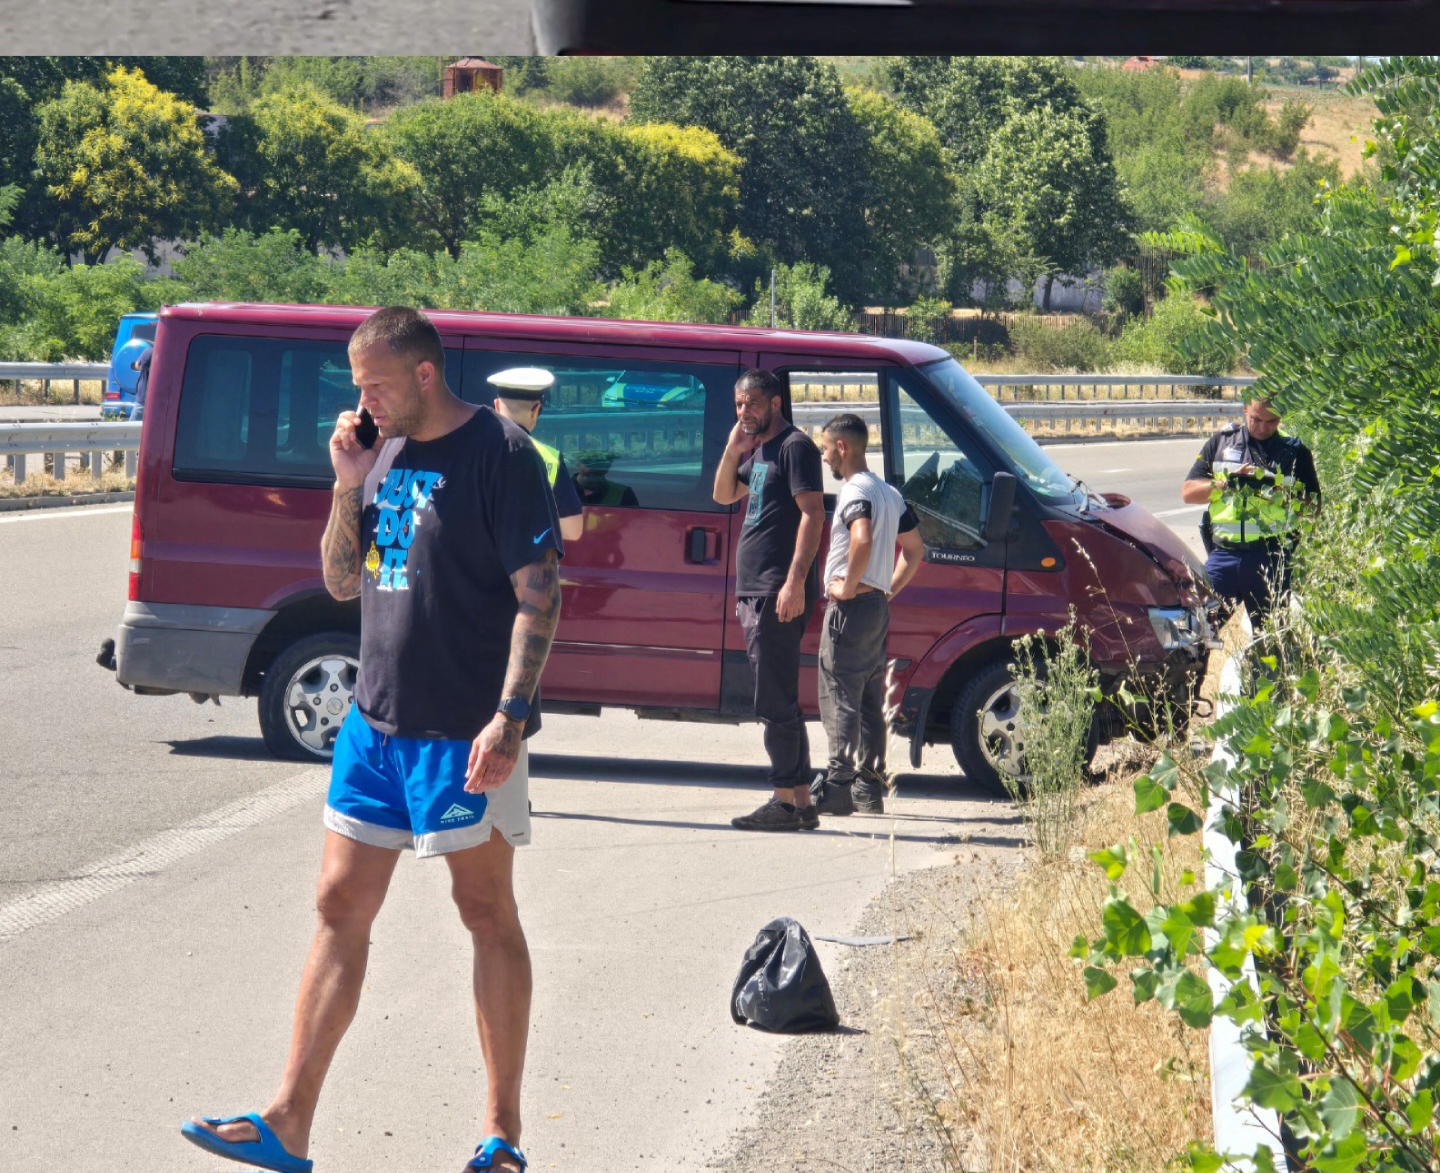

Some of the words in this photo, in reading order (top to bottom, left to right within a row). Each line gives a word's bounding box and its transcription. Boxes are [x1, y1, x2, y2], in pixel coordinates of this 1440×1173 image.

[373, 468, 443, 509] JUST
[376, 506, 416, 548] DO
[931, 551, 975, 562] TOURNEO
